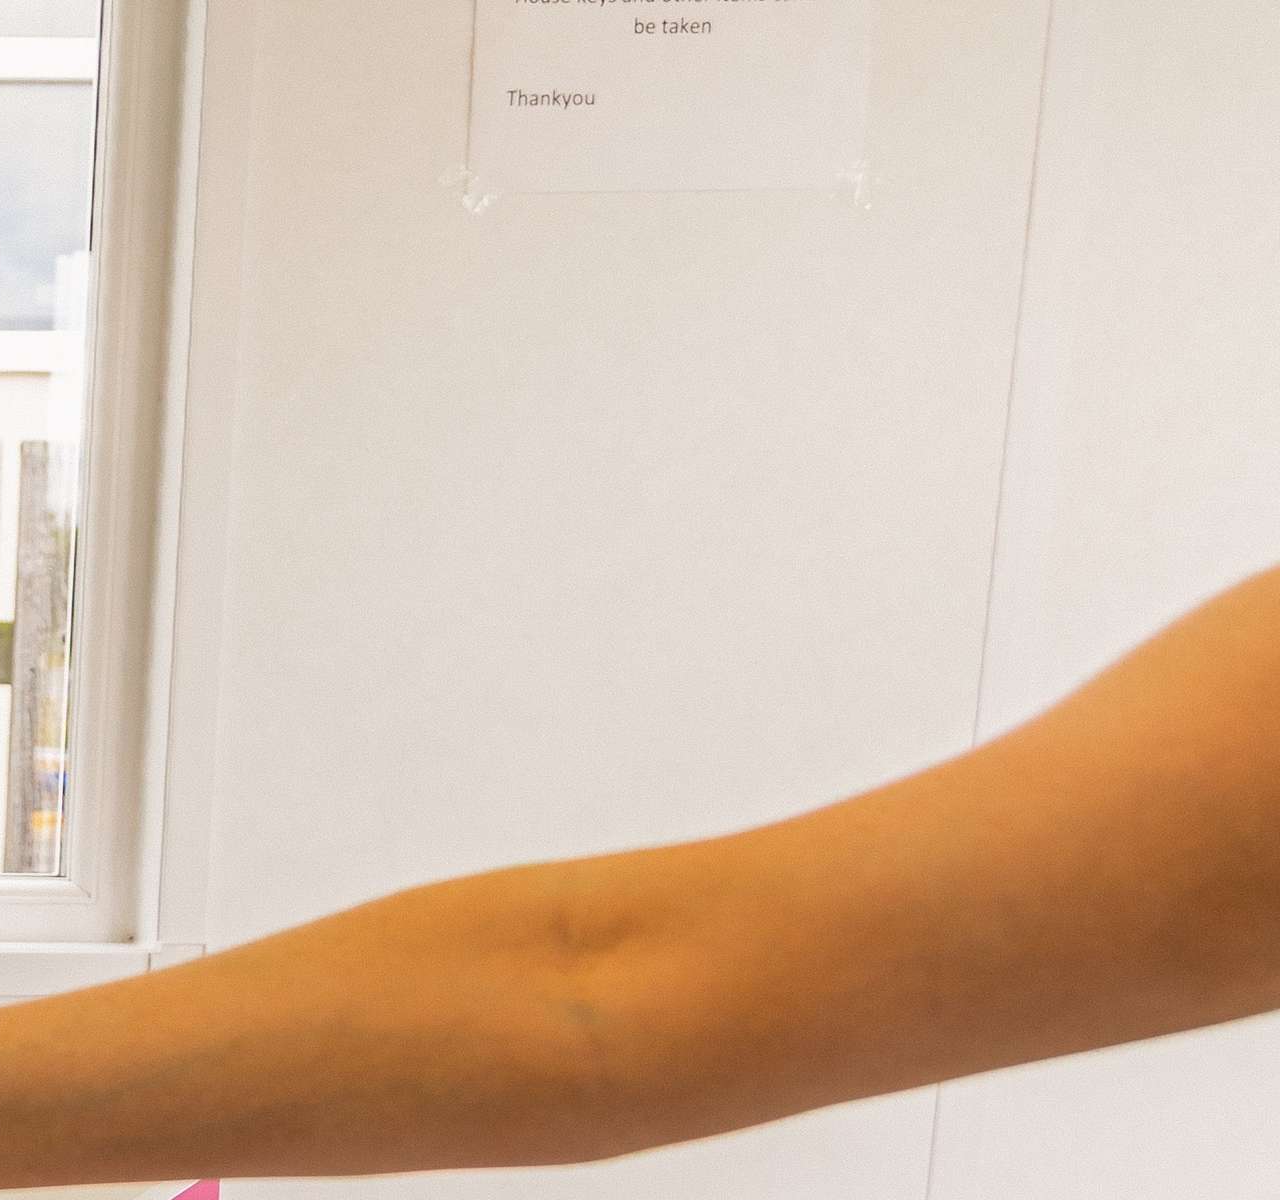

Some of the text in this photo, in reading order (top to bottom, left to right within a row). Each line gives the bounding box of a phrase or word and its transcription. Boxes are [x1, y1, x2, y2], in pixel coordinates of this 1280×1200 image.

[633, 17, 712, 34] be taken
[506, 89, 595, 110] Thankyou
